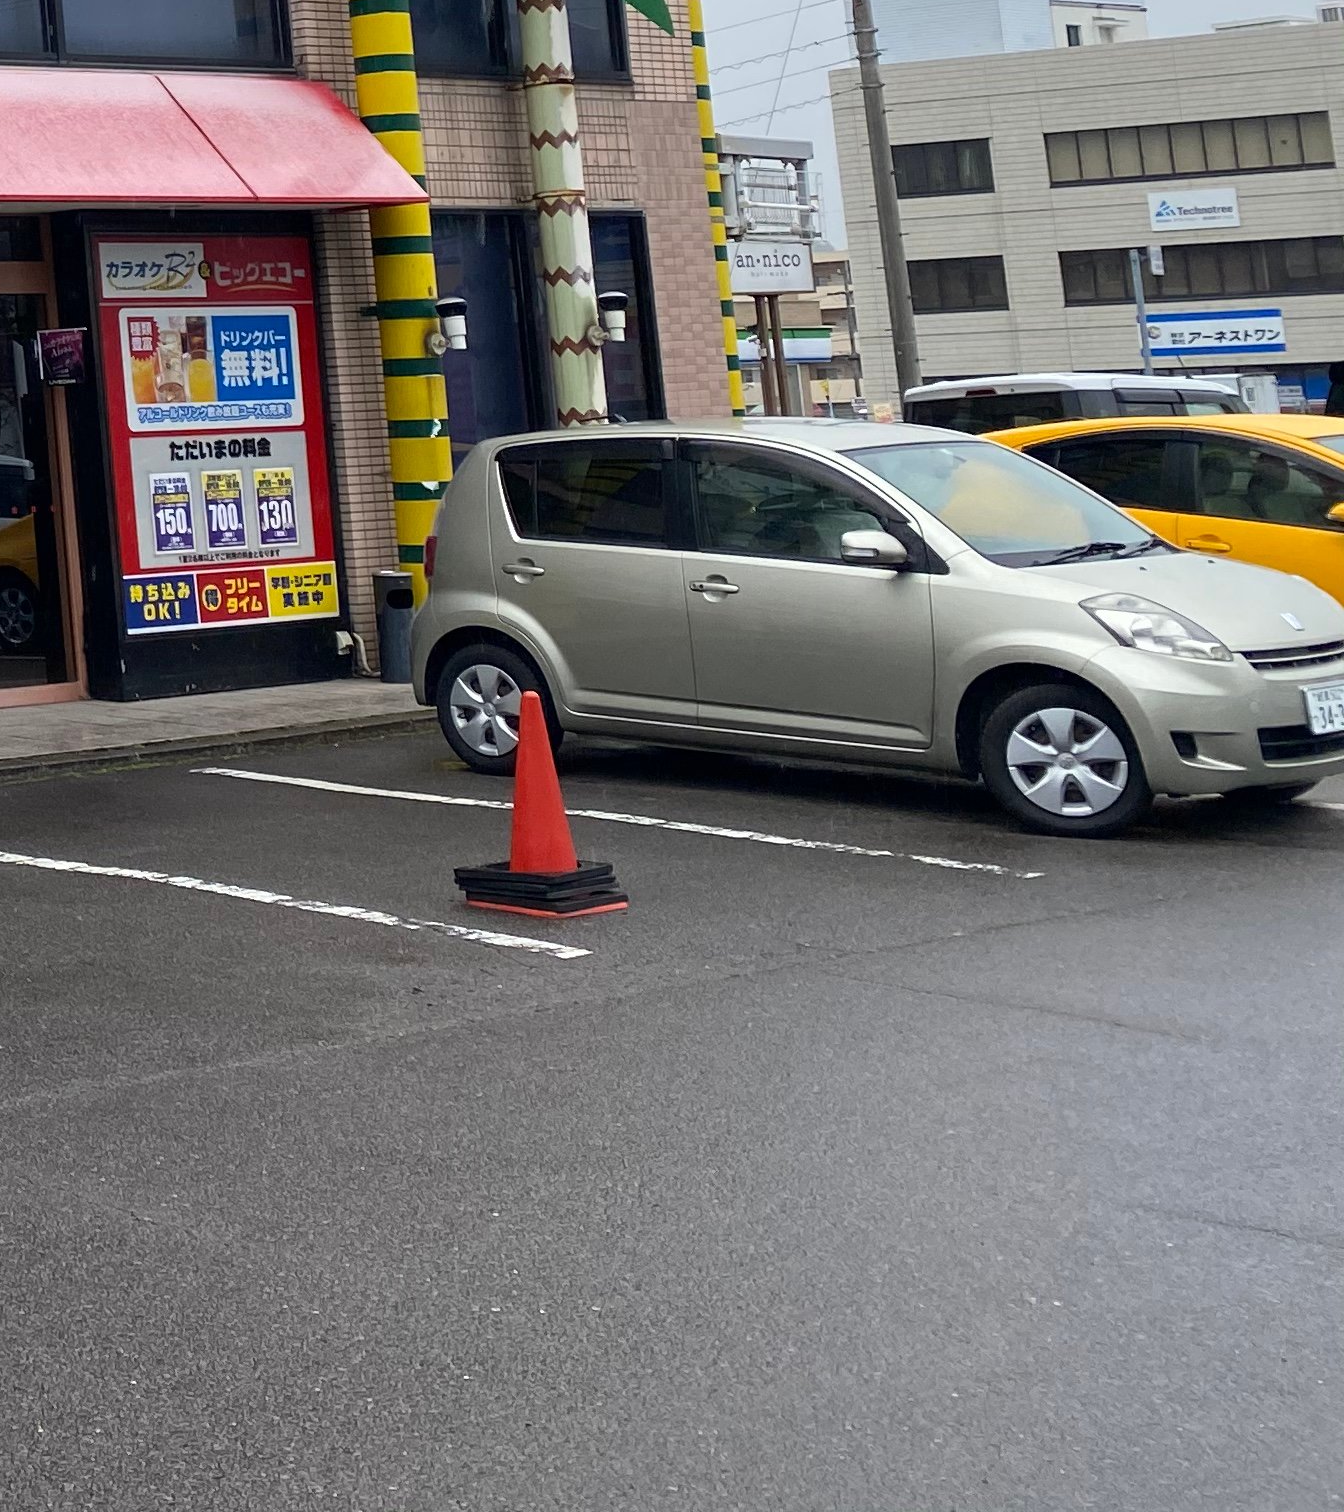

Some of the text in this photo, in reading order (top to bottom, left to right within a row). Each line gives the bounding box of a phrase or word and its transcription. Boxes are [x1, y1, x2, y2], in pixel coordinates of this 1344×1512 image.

[106, 261, 163, 279] カラオケ
[220, 330, 286, 347] ドリンクバー
[1188, 329, 1280, 345] アーネストワン
[221, 348, 289, 387] 無料!
[169, 438, 272, 461] ただいまの料金
[156, 508, 187, 535] 150
[129, 582, 191, 603] 持ち込み
[224, 577, 261, 595] フリー
[226, 595, 263, 614] タイム
[283, 590, 324, 608] 実施中
[143, 601, 180, 621] OK!
